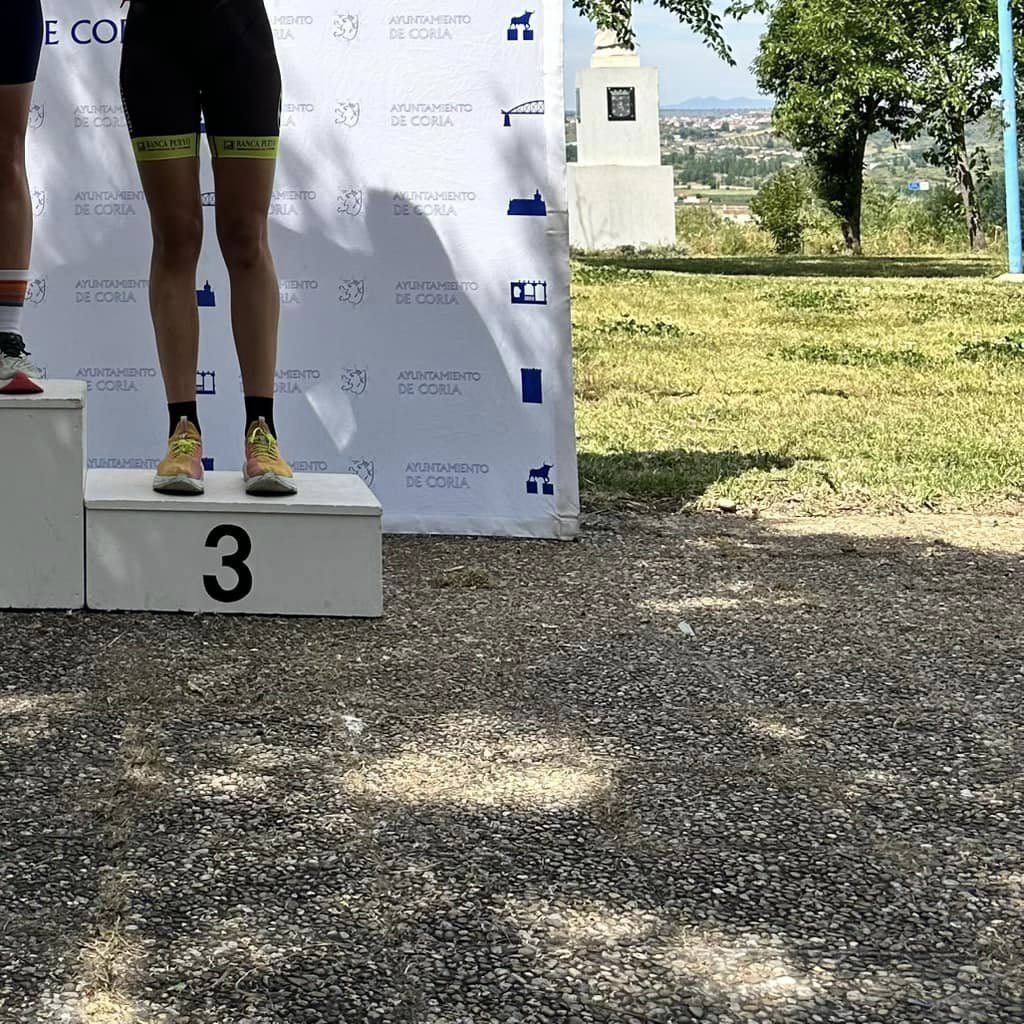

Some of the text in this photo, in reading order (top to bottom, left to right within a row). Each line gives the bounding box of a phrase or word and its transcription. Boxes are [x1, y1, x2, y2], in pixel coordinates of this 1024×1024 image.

[388, 14, 471, 25] AYUNTAMIENTO
[389, 27, 452, 40] DE CORIA
[390, 102, 473, 113] AYUNTAMIENTO
[74, 116, 88, 128] DE
[391, 115, 454, 127] DE CORIA
[393, 190, 476, 202] AYUNTAMIENTO
[75, 204, 135, 215] DE CORIA
[393, 204, 457, 216] DE CORIA
[395, 280, 479, 291] AYUNTAMIENTO
[75, 292, 136, 304] DE CORIA
[396, 293, 458, 305] DE CORIA
[77, 367, 156, 378] AYUNTAMIENTO
[398, 371, 481, 382] AYUNTAMIENTO
[97, 380, 138, 392] CORIA
[398, 383, 462, 395] DE CORIA
[405, 462, 489, 475] AYUNTAMIENTO
[406, 476, 470, 489] DE CORIA
[202, 523, 253, 603] 3
